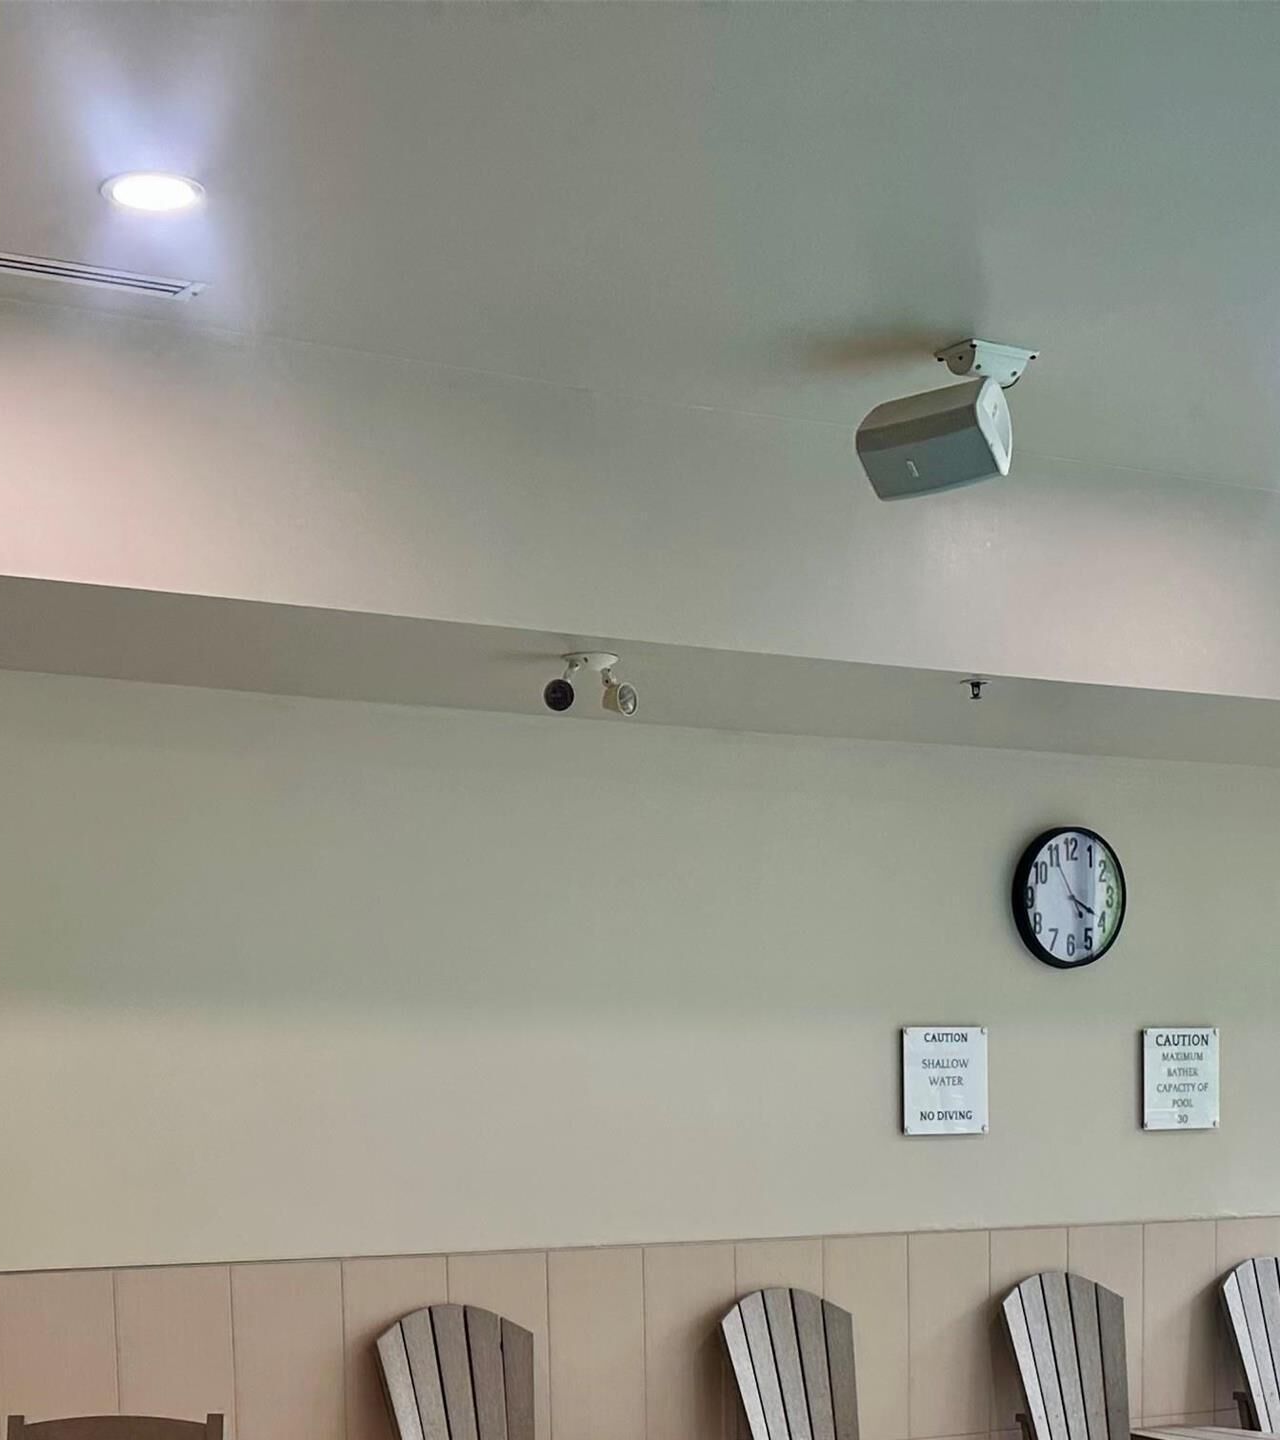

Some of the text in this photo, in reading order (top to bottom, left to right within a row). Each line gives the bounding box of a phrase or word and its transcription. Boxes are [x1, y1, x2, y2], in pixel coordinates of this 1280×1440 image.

[1047, 843, 1060, 867] 11
[1063, 837, 1078, 861] 12
[1087, 844, 1093, 868] 1
[1033, 860, 1048, 884] 10
[1098, 859, 1107, 882] 2
[1025, 886, 1035, 909] 9
[1106, 885, 1115, 908] 3
[1033, 912, 1042, 934] 8
[1097, 911, 1106, 933] 4
[1048, 928, 1059, 950] 7
[1067, 934, 1075, 956] 6
[1084, 928, 1093, 950] 5
[924, 1033, 968, 1043] CAUTION
[1155, 1034, 1209, 1046] CAUTION
[922, 1059, 968, 1069] SHALLOW
[1162, 1052, 1203, 1062] MAXIMUM
[928, 1076, 964, 1086] WATER
[1167, 1067, 1199, 1078] BATHER
[1156, 1082, 1208, 1093] CAPACITY OF
[1172, 1098, 1194, 1108] POOL
[920, 1110, 973, 1121] NO DIVING
